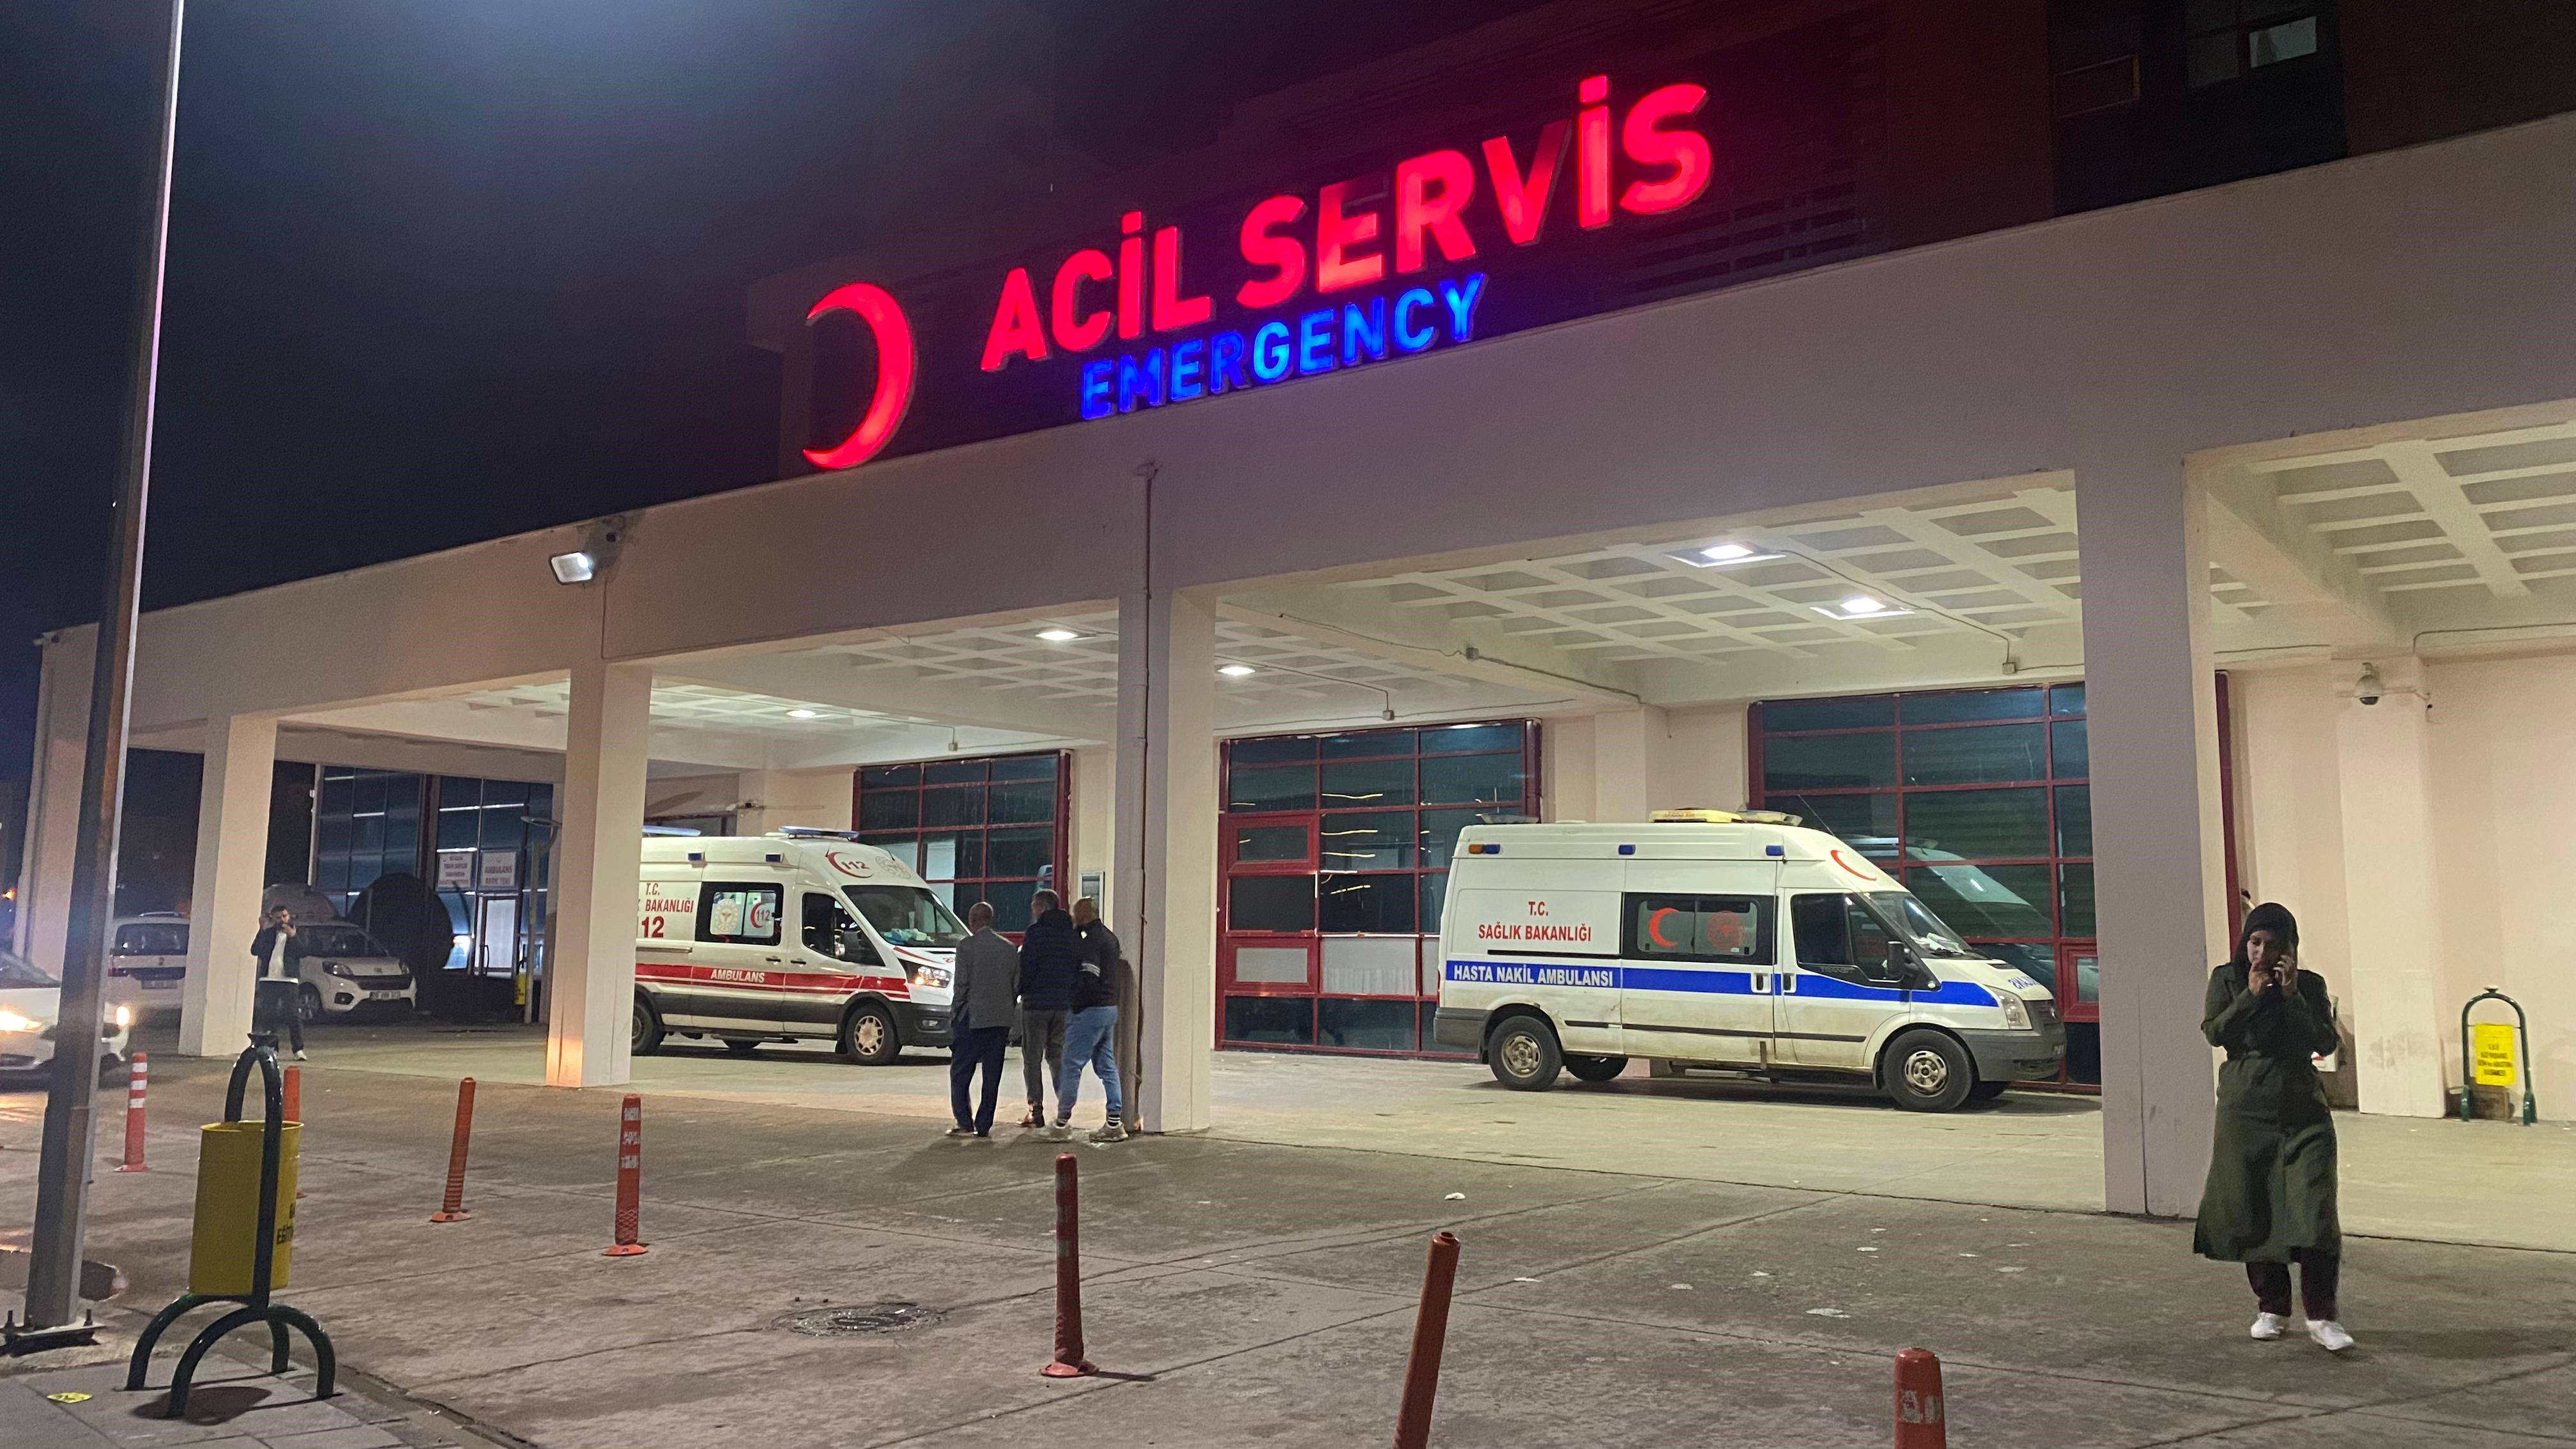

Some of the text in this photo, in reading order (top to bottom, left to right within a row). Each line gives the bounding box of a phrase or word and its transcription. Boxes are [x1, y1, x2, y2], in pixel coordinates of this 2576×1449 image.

[981, 74, 1713, 372] ACİL SERVİS
[1081, 273, 1485, 420] EMERGENCY
[841, 861, 870, 870] 112
[645, 883, 660, 896] T.C.
[645, 897, 694, 913] BAKANLIĞI
[1528, 901, 1549, 916] T.C.
[756, 910, 770, 921] 112
[637, 916, 664, 939] 12
[1478, 921, 1591, 942] SAĞLIK BAKANLIĞI
[710, 969, 765, 983] AMBULANS
[1453, 964, 1614, 987] HASTA NAKİL AMBULANSI
